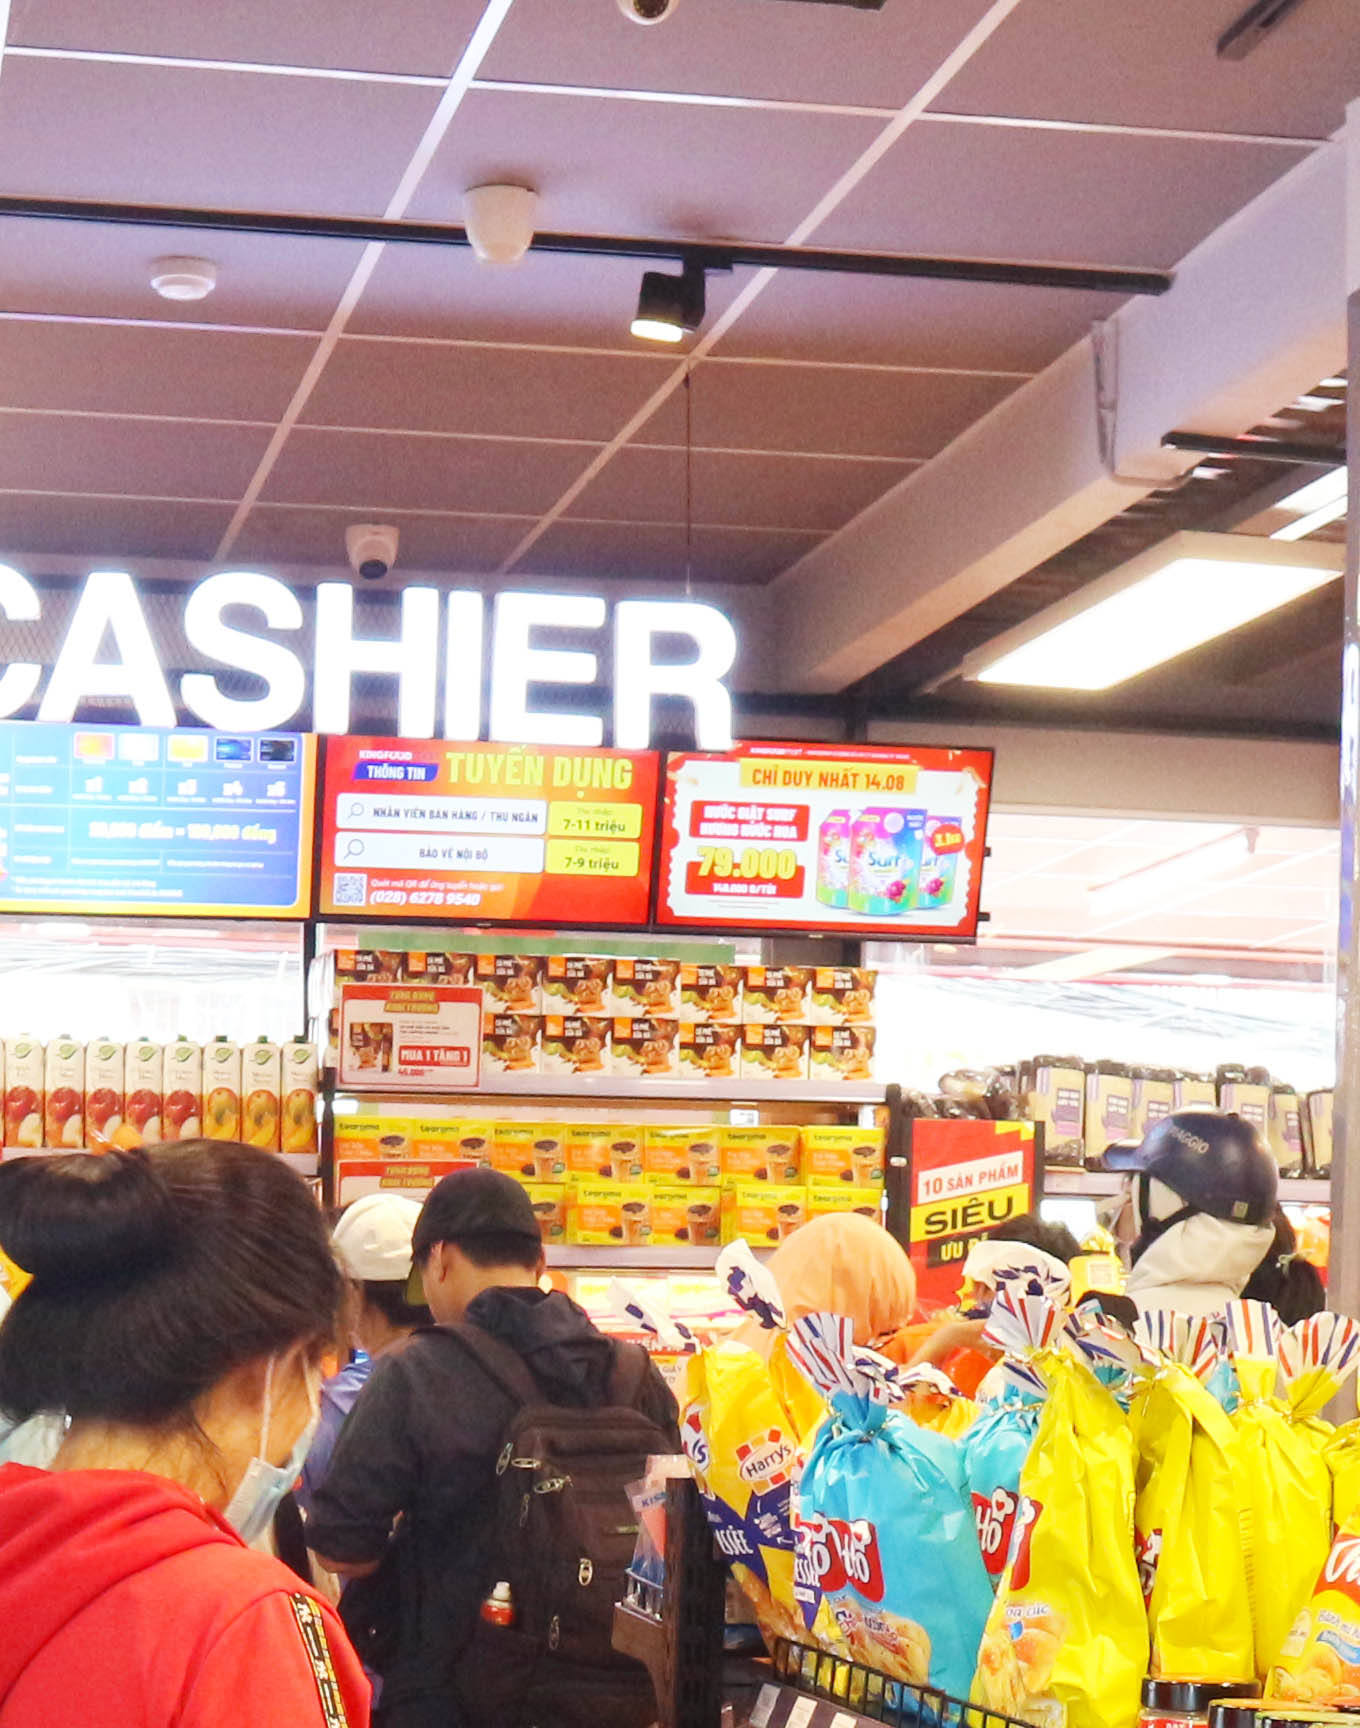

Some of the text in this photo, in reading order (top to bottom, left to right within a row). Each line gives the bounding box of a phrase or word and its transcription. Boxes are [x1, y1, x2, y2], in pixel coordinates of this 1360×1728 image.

[366, 763, 426, 780] THÔNG TIN
[552, 757, 633, 799] DỤNG
[781, 770, 811, 786] DUY
[818, 766, 860, 789] NHẤT
[864, 773, 905, 791] 14.08
[563, 819, 626, 834] 7-11 triệu
[563, 857, 620, 872] 7-9 triệu
[696, 846, 797, 880] 79.000
[369, 891, 481, 906] (028) 6278 9540
[923, 1161, 1019, 1196] 10 SẢN PHẨM
[924, 1196, 1014, 1235] SIÊU
[745, 1441, 792, 1480] Harry's
